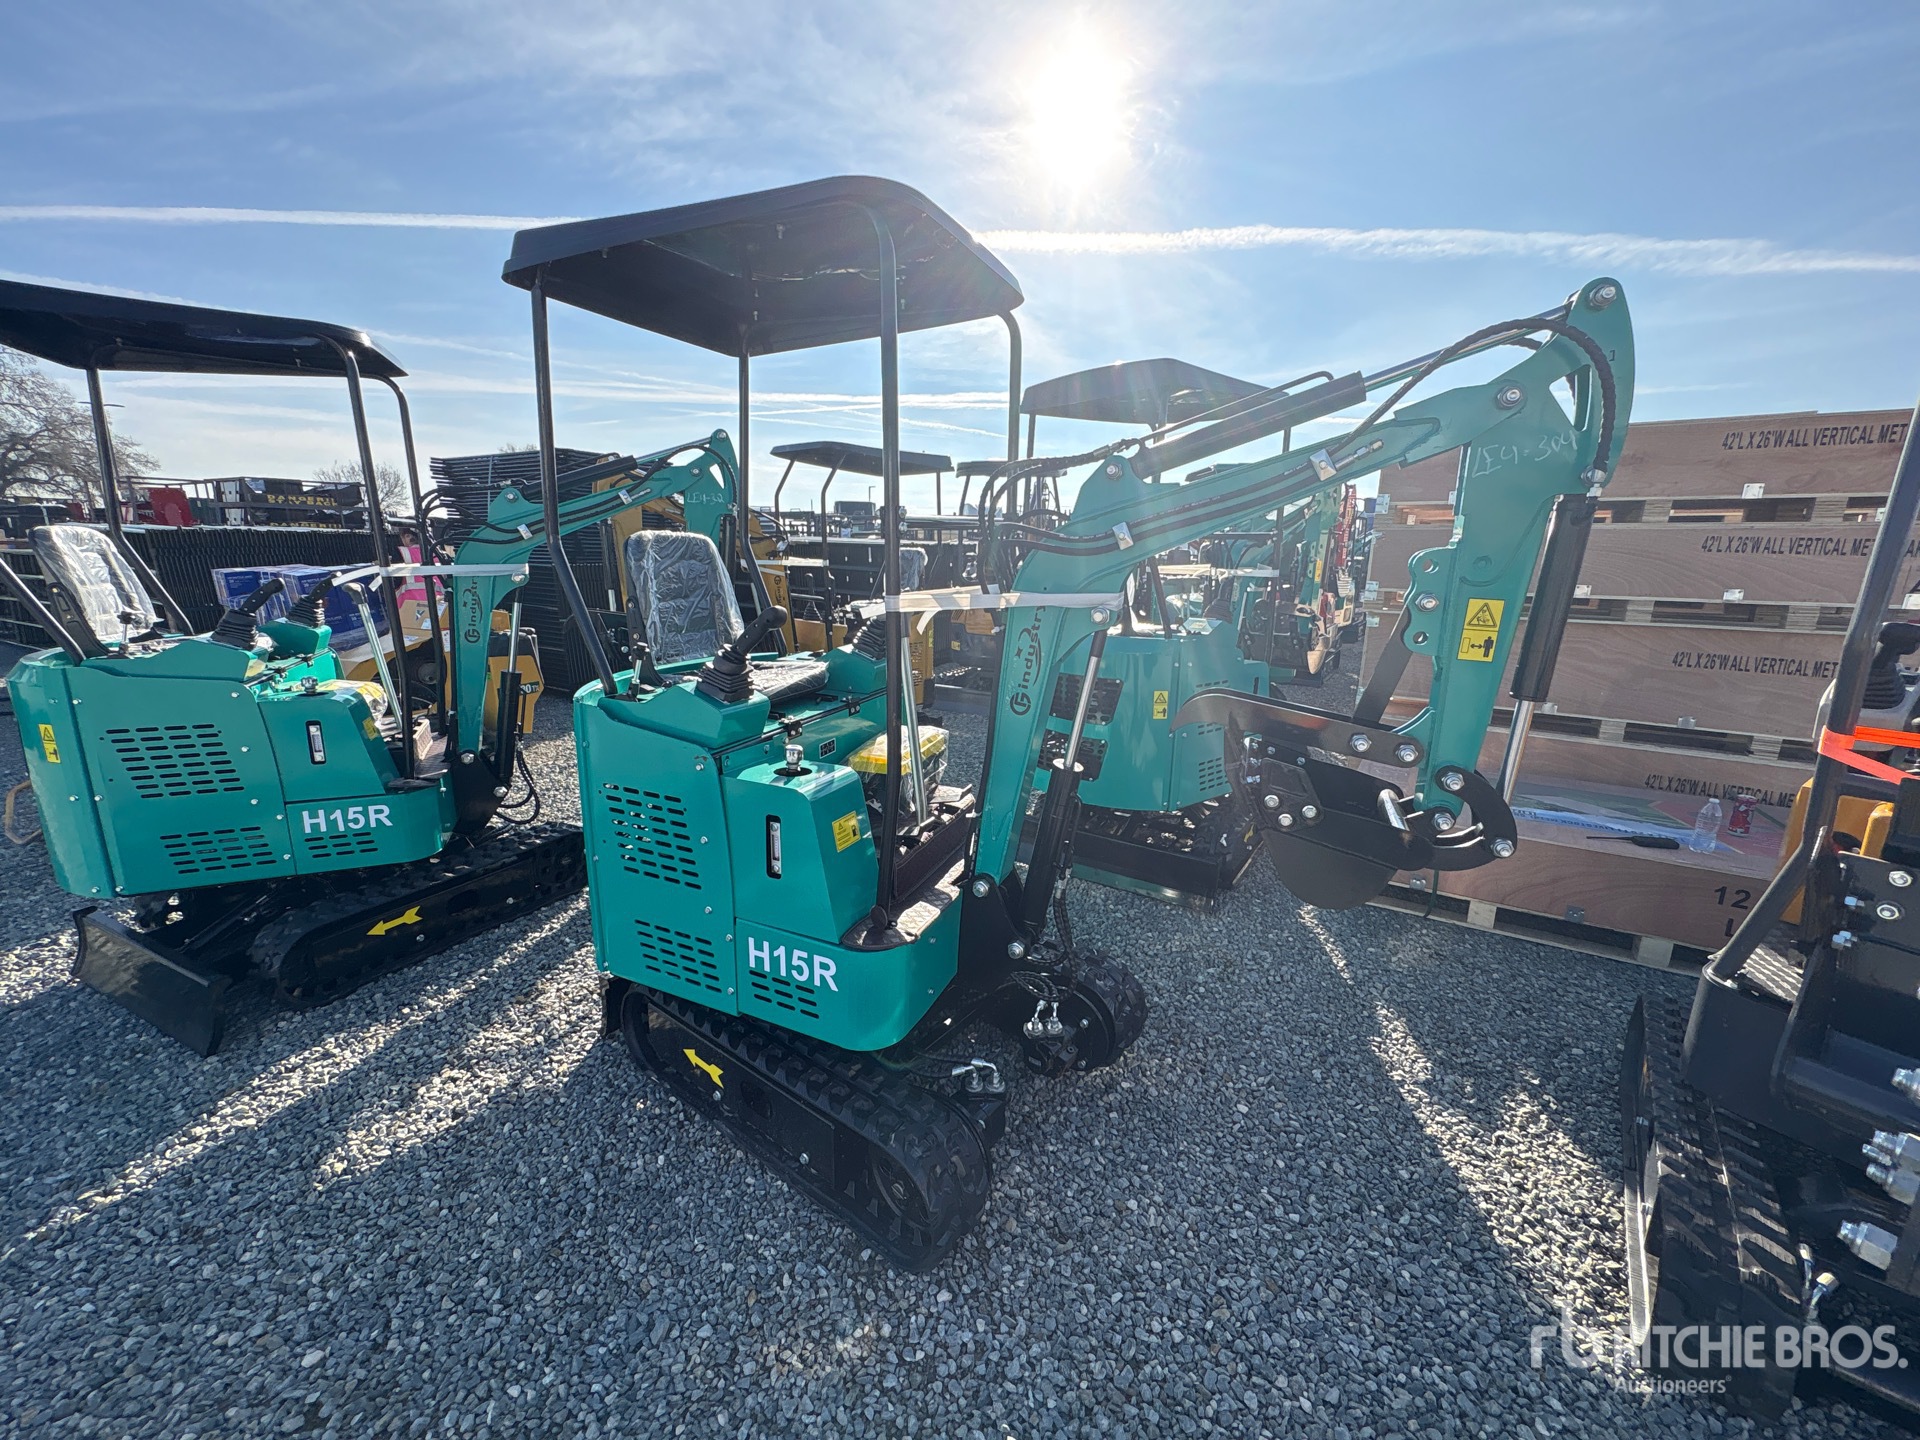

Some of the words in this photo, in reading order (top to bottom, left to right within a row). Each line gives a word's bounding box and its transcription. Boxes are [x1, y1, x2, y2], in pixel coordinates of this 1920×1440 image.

[1745, 431, 1756, 449] X
[1785, 428, 1809, 448] ALL
[1813, 425, 1875, 446] VERTICAL
[1877, 423, 1909, 444] MET
[1724, 536, 1735, 553] X
[1763, 537, 1785, 555] ALL
[1789, 537, 1848, 556] VERTICAL
[1693, 652, 1703, 669] X
[1730, 655, 1751, 672] ALL
[1754, 656, 1810, 678] VERTICAL
[1811, 661, 1840, 679] MET
[1663, 776, 1673, 792] X
[1699, 780, 1719, 799] ALL
[1776, 791, 1797, 809] ME
[302, 804, 394, 834] H15R
[1714, 886, 1752, 910] 12
[748, 936, 839, 992] H15R
